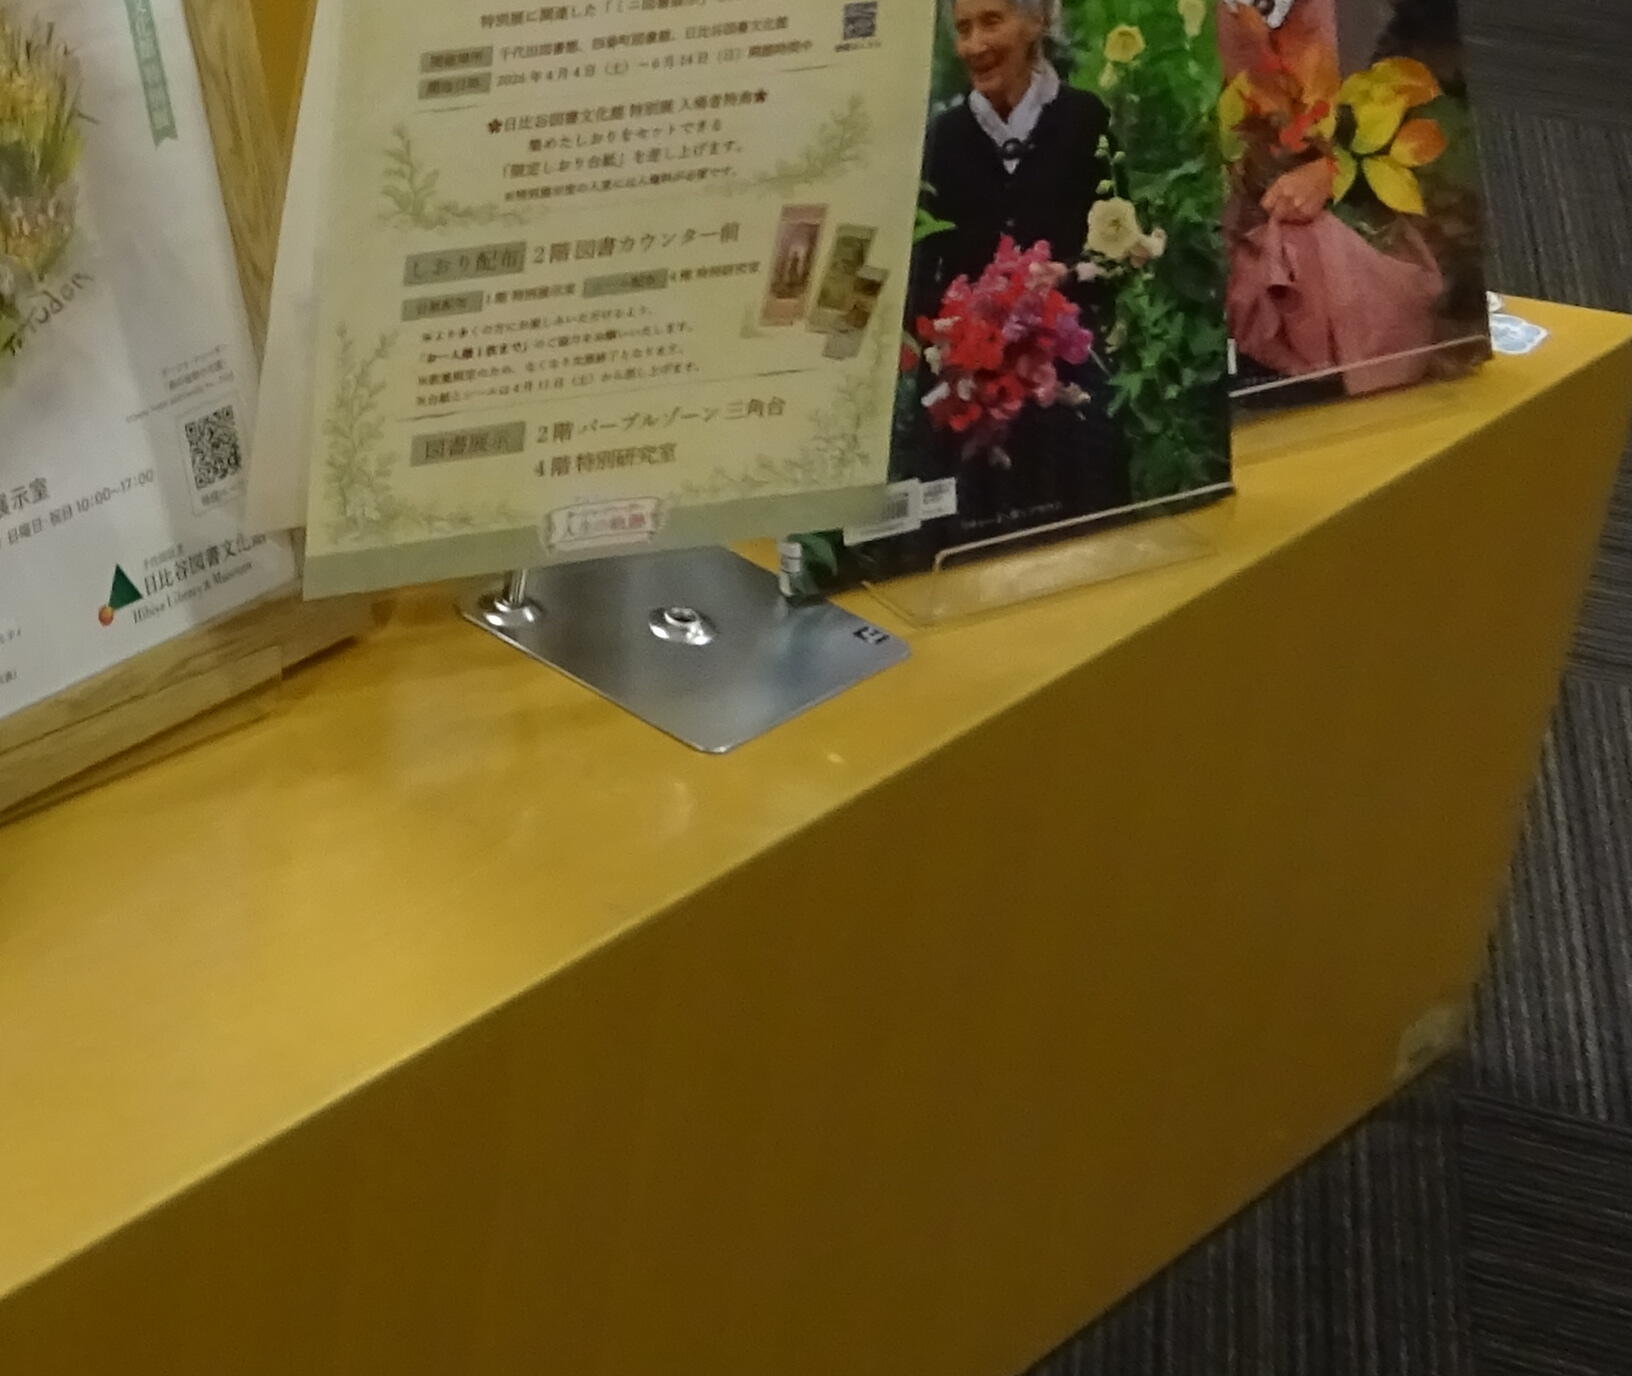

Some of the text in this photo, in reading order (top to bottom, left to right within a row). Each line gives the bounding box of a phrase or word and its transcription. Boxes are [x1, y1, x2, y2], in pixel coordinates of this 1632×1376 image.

[409, 243, 522, 283] しおり配布
[574, 217, 741, 265] 図書カウンター前
[423, 392, 786, 462] 図書展示 2階 パープルゾーン 三角台
[532, 439, 677, 482] 4階 特別研究室
